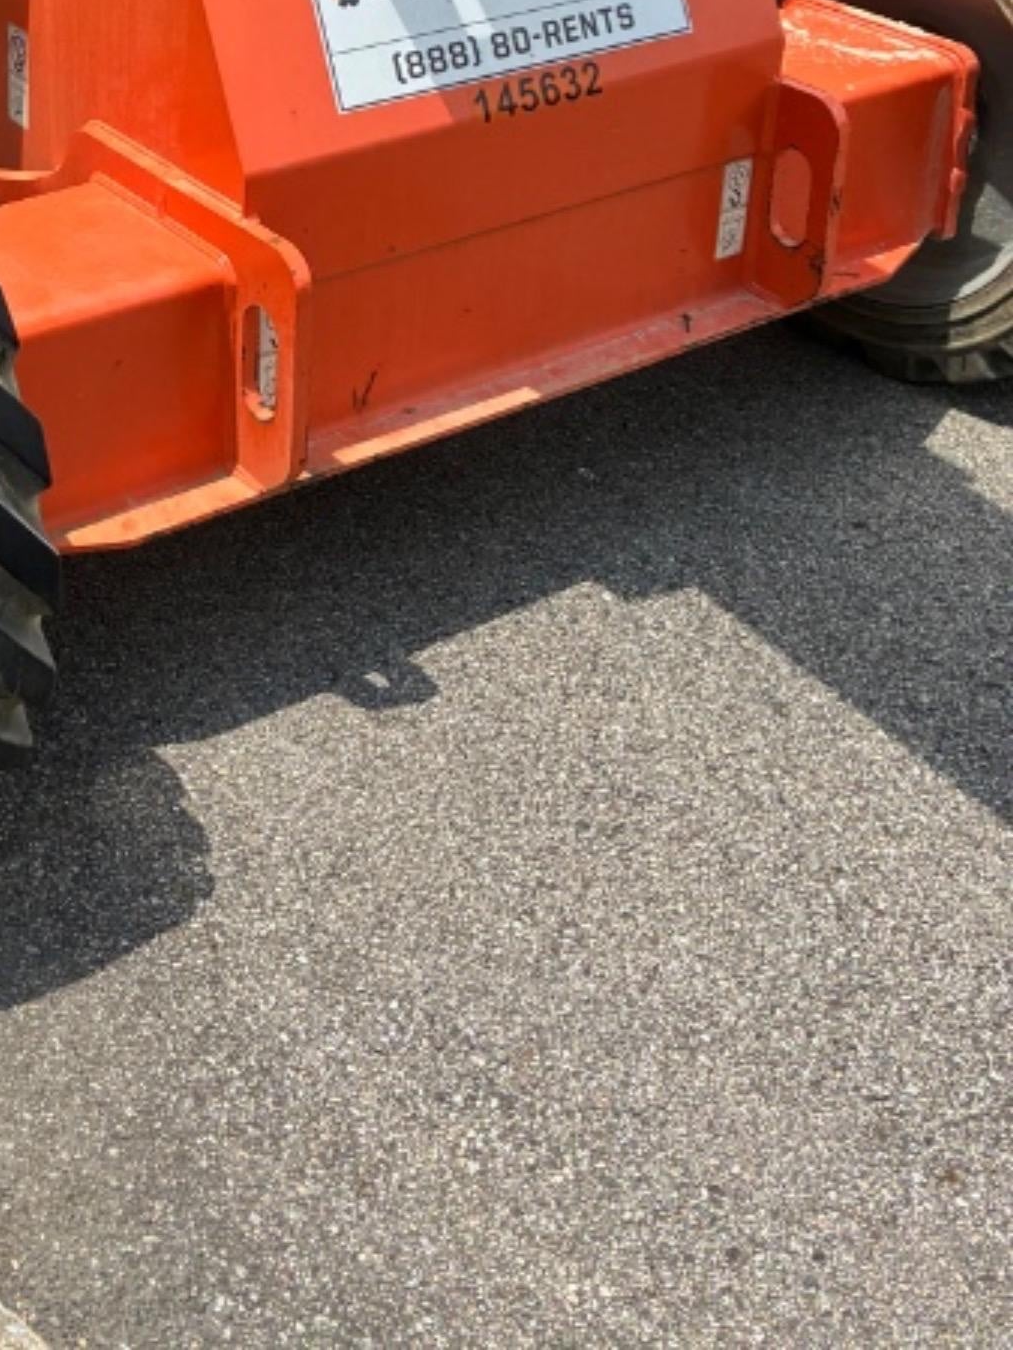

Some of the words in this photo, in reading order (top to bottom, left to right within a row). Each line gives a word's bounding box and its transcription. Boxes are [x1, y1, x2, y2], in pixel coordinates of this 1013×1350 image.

[392, 35, 480, 82] (888)
[491, 3, 635, 59] 80-RENTS
[475, 62, 602, 123] 145632
